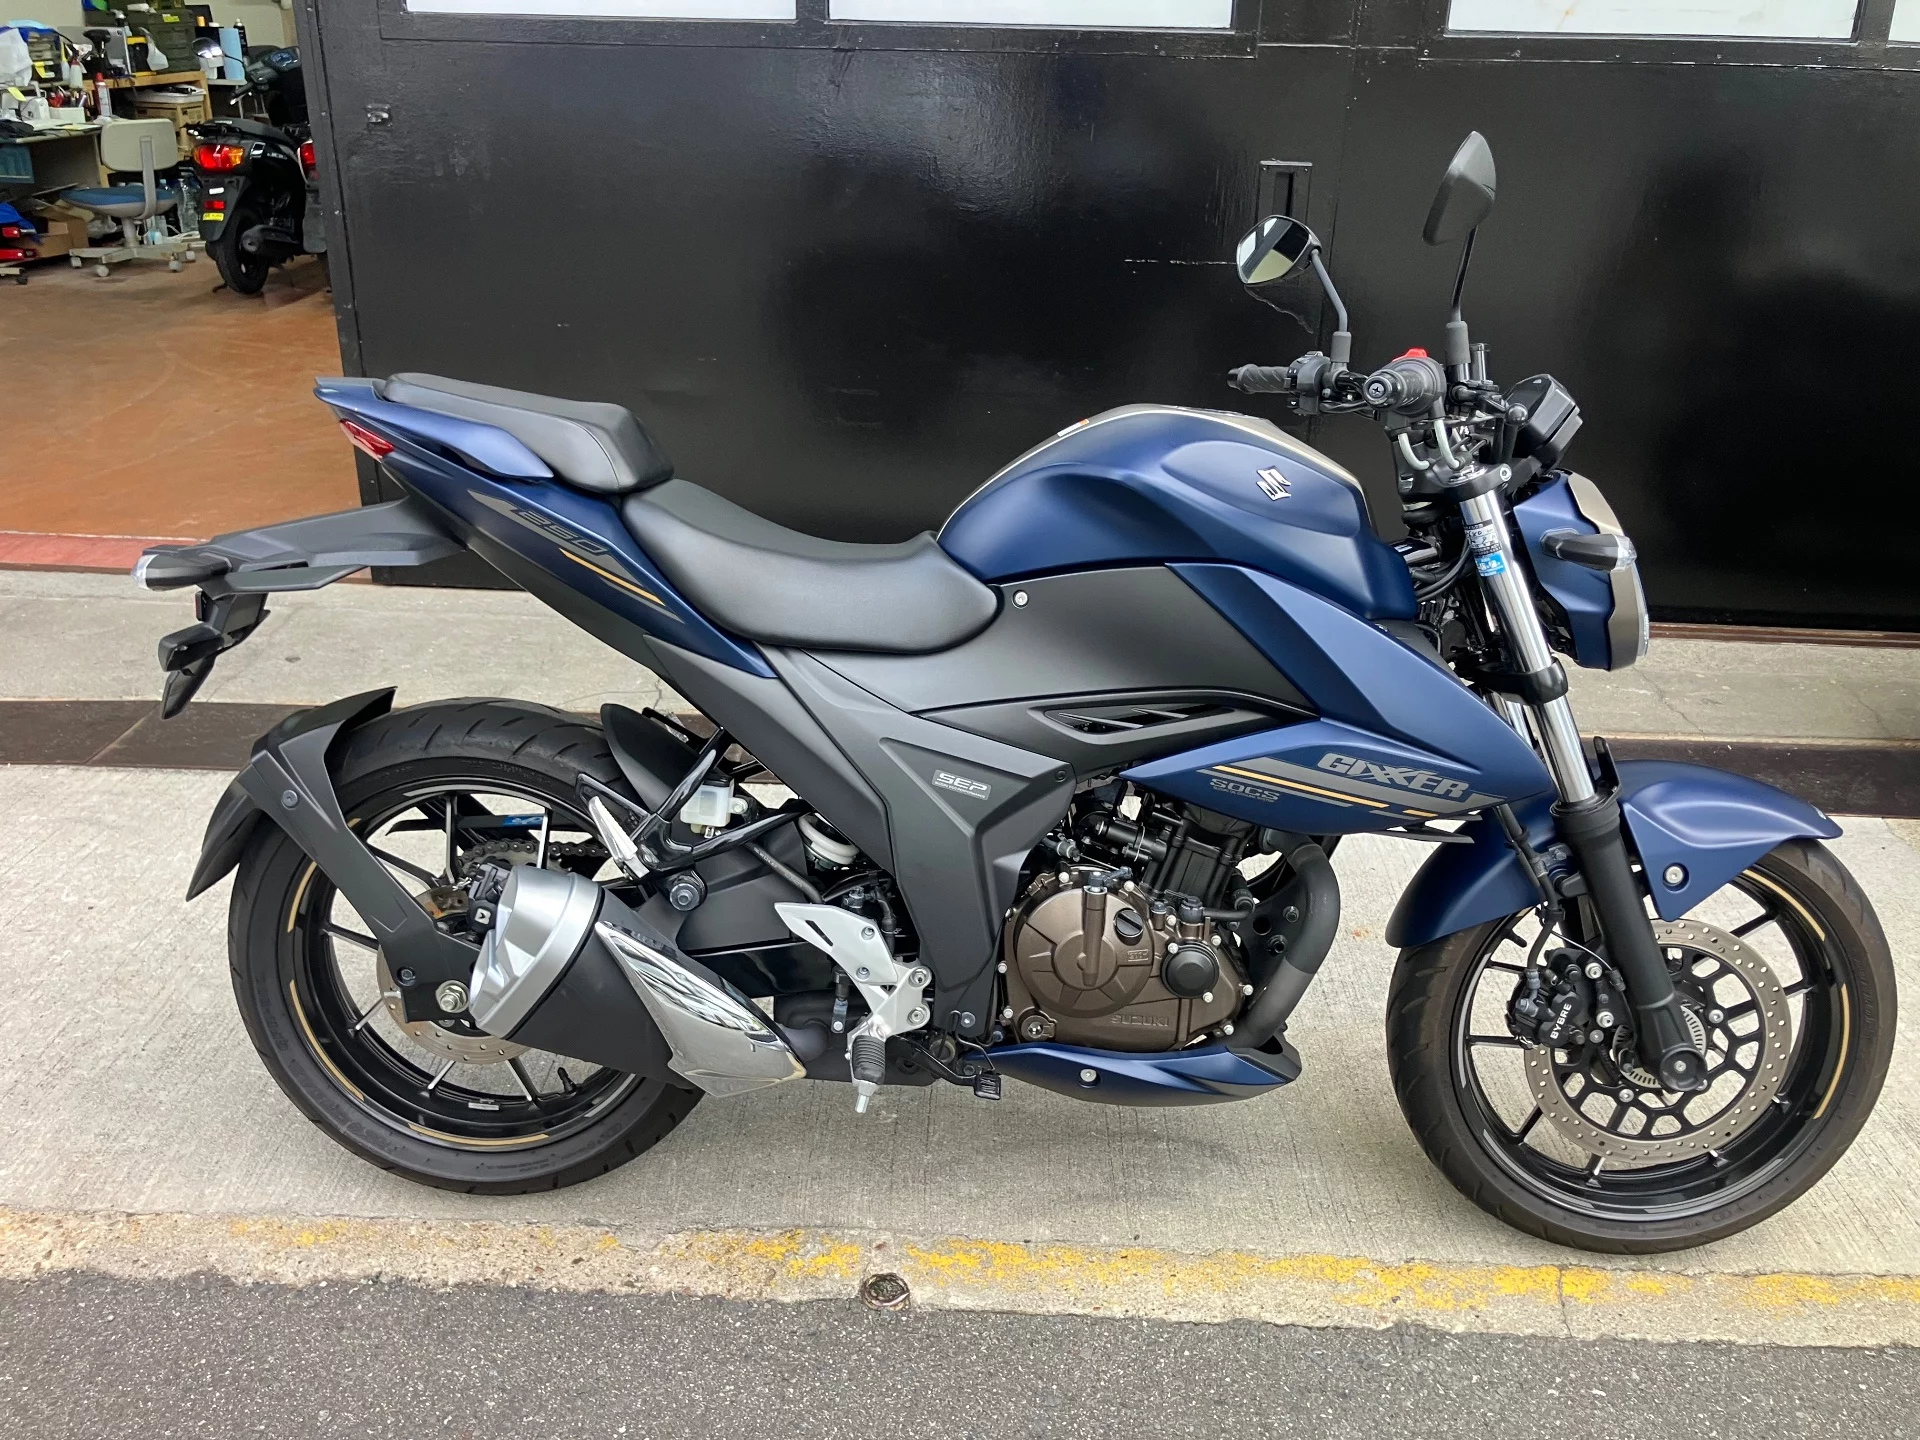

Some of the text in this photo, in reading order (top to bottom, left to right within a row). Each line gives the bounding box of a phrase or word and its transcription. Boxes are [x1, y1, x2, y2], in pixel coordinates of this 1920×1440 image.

[518, 510, 608, 555] 250
[937, 773, 988, 791] SEP
[1317, 752, 1470, 798] GIXXER
[1210, 779, 1280, 800] SOCS
[1111, 1014, 1169, 1027] SUZUKI
[1550, 1003, 1572, 1039] BYBRE
